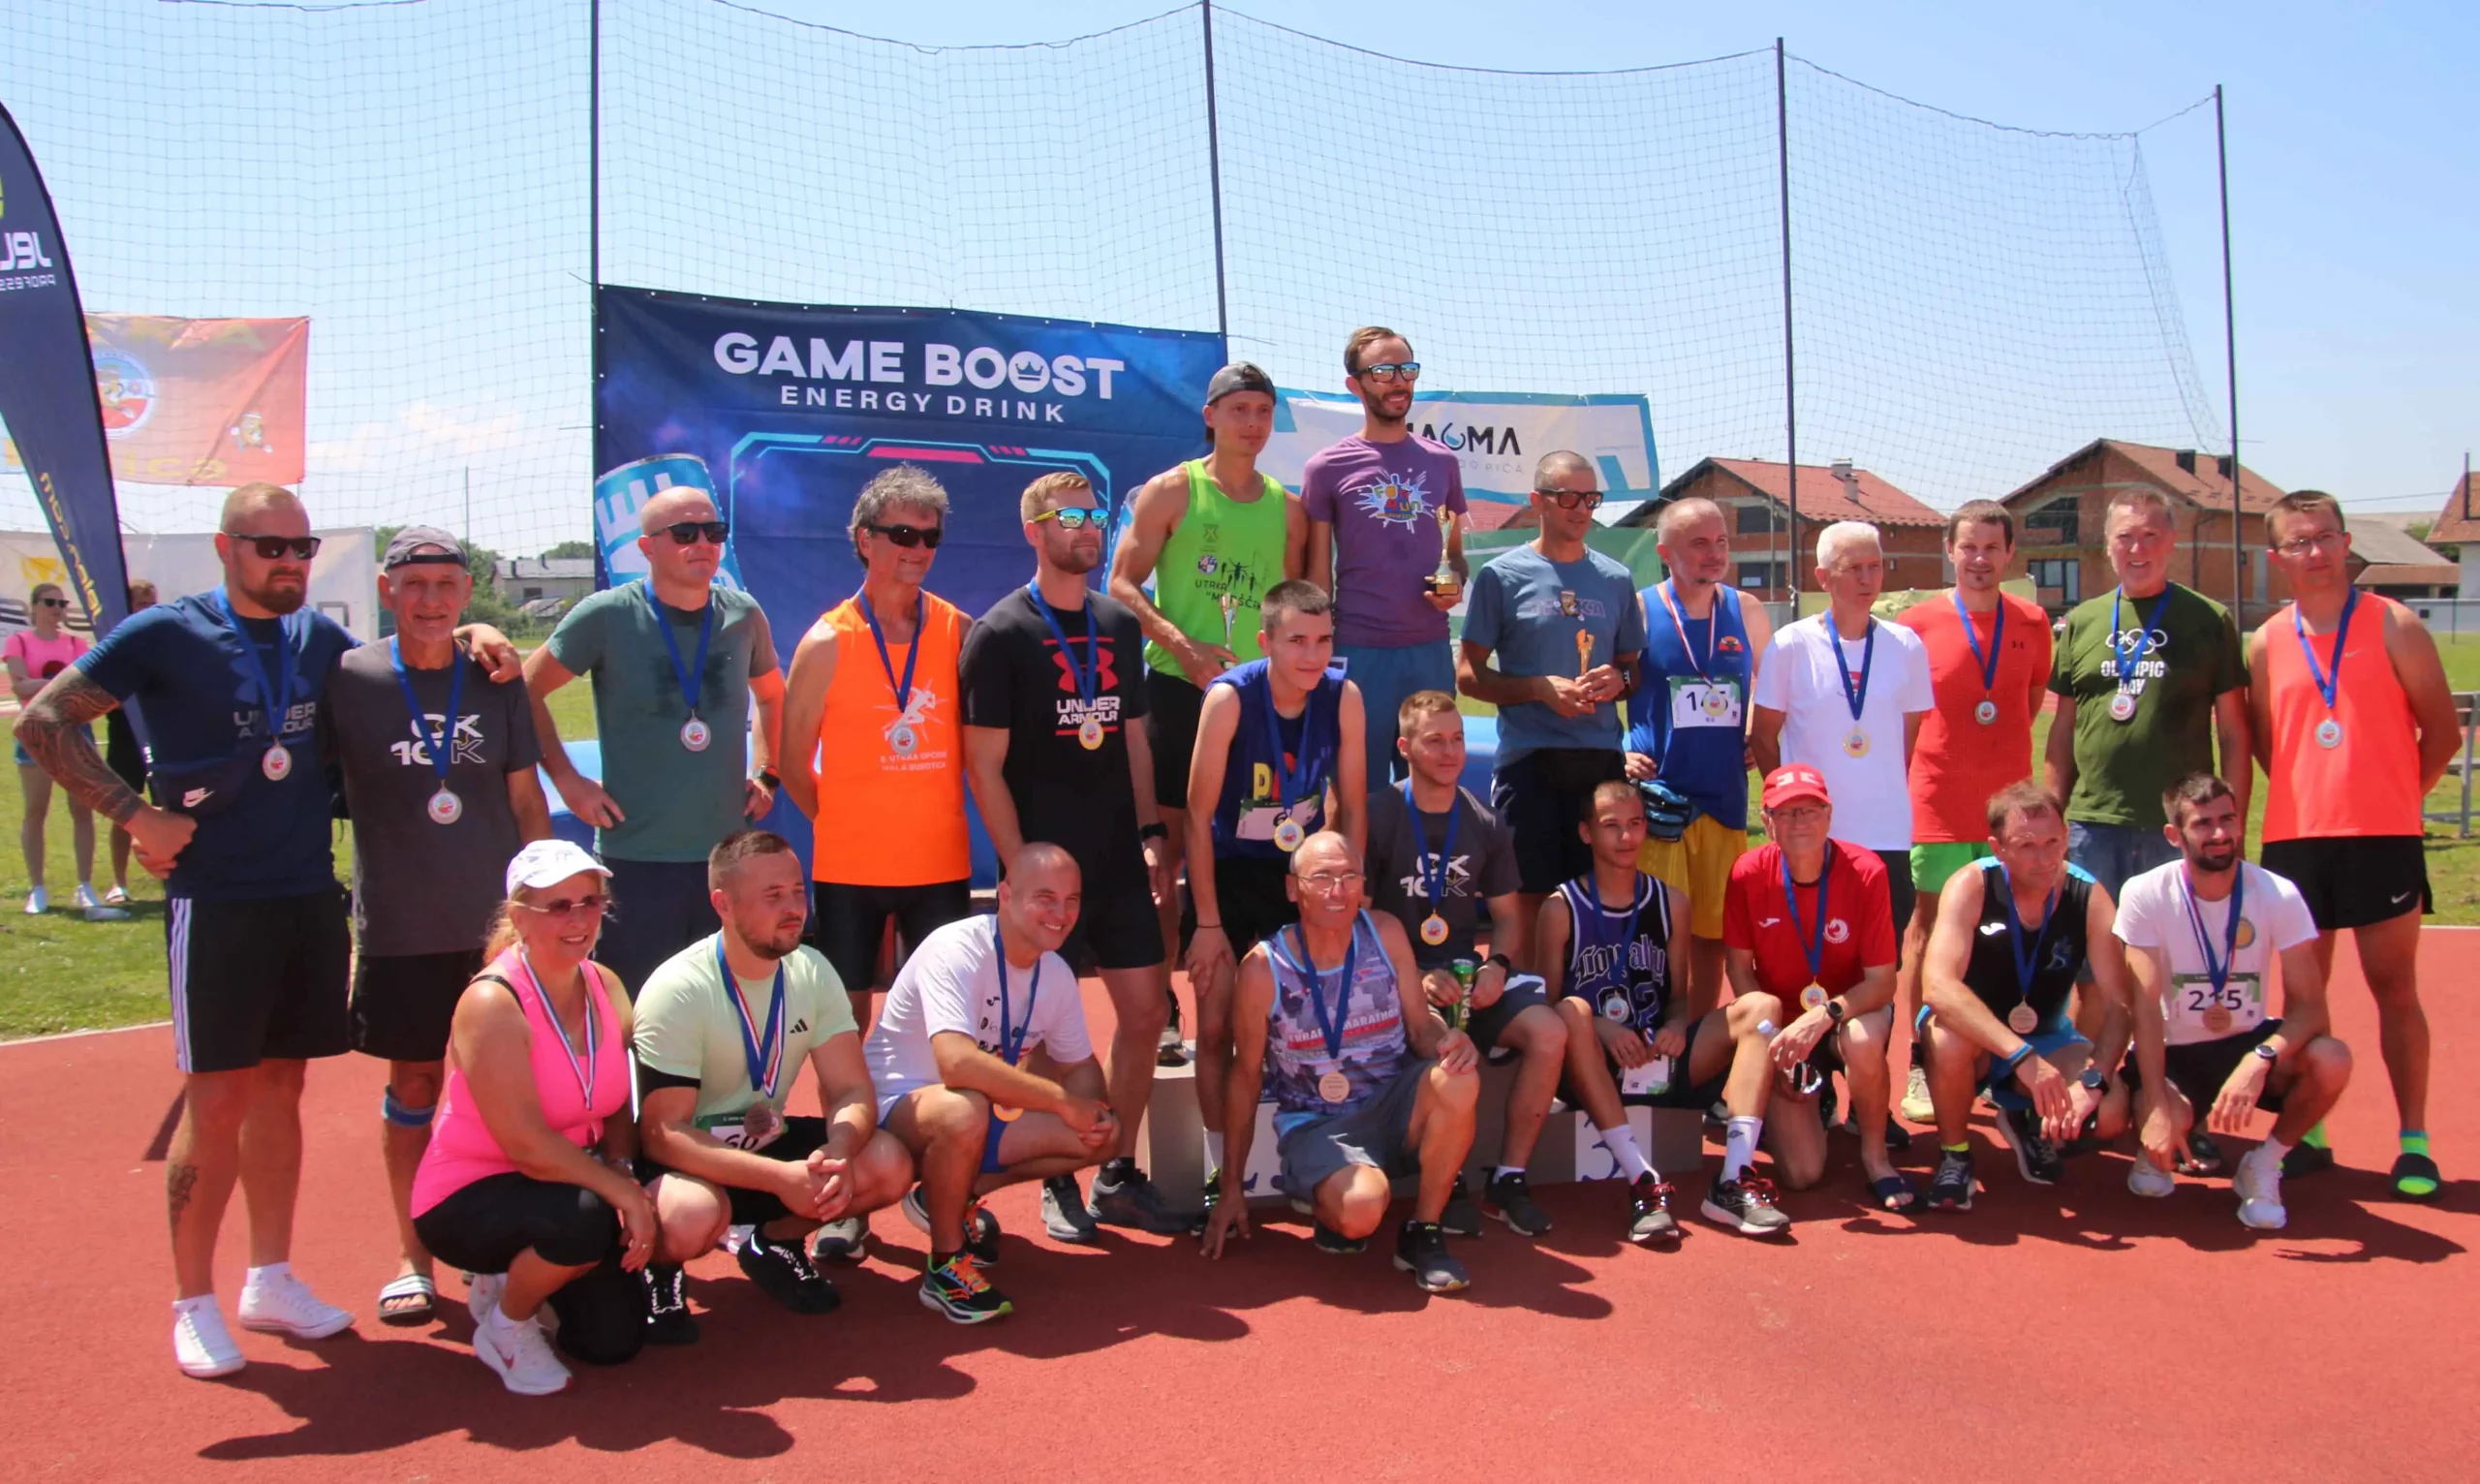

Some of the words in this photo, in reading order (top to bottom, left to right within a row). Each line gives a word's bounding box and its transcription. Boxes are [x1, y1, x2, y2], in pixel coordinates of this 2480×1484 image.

[714, 332, 904, 383] GAME
[925, 343, 1125, 400] BOOST
[781, 386, 932, 413] ENERGY
[946, 395, 1064, 423] DRINK
[2100, 660, 2165, 678] OLPIC
